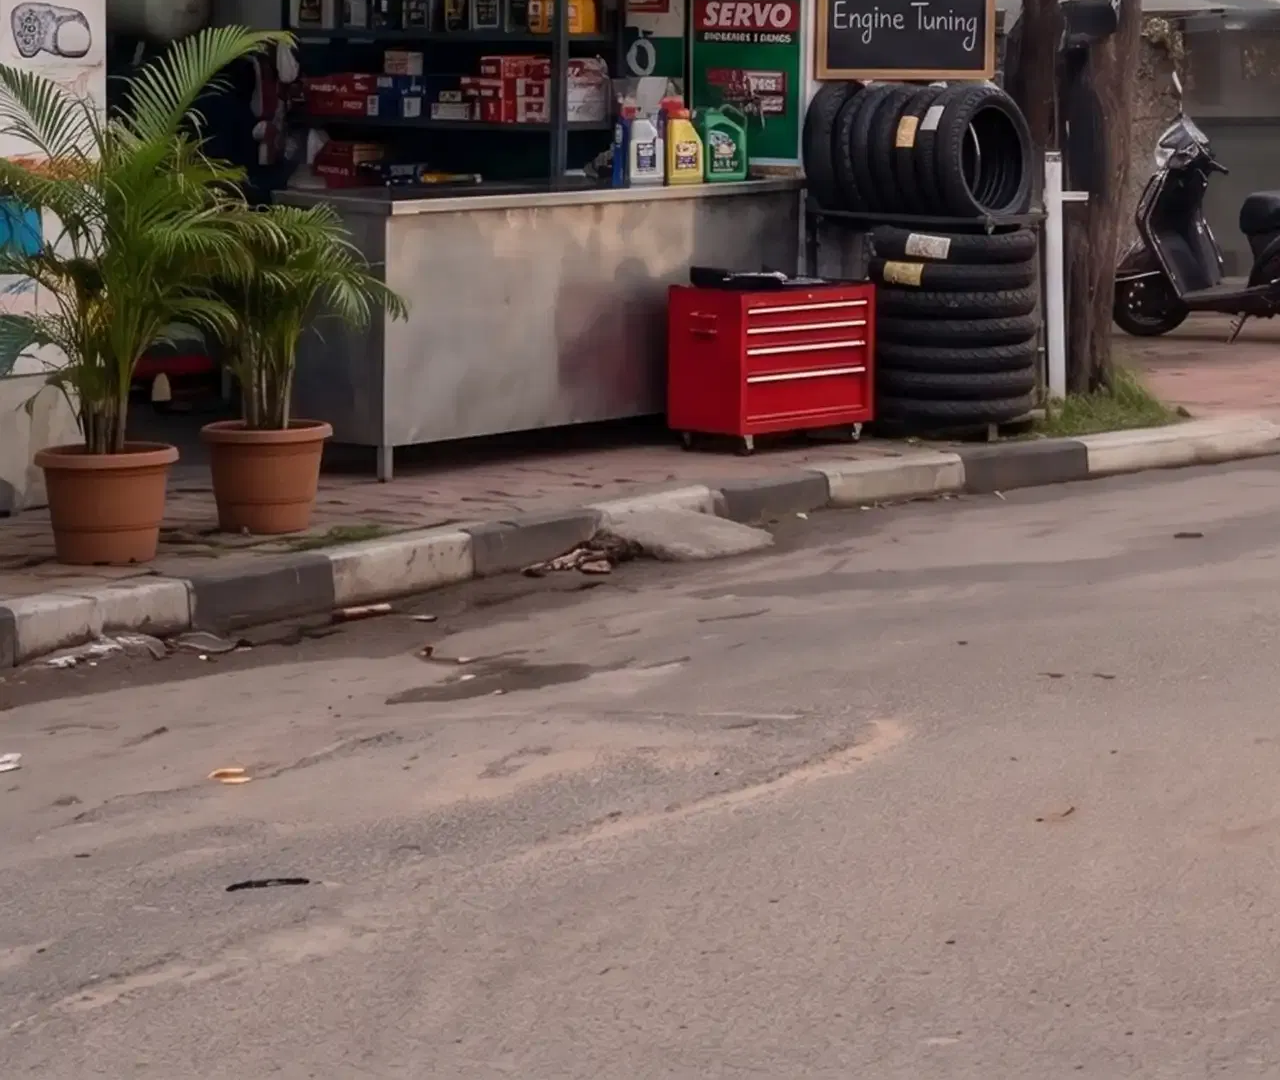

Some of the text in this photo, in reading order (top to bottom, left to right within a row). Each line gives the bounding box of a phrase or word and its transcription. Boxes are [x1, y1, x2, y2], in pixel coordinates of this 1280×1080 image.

[702, 1, 792, 29] SERVO
[833, 0, 977, 52] Engine Tuning
